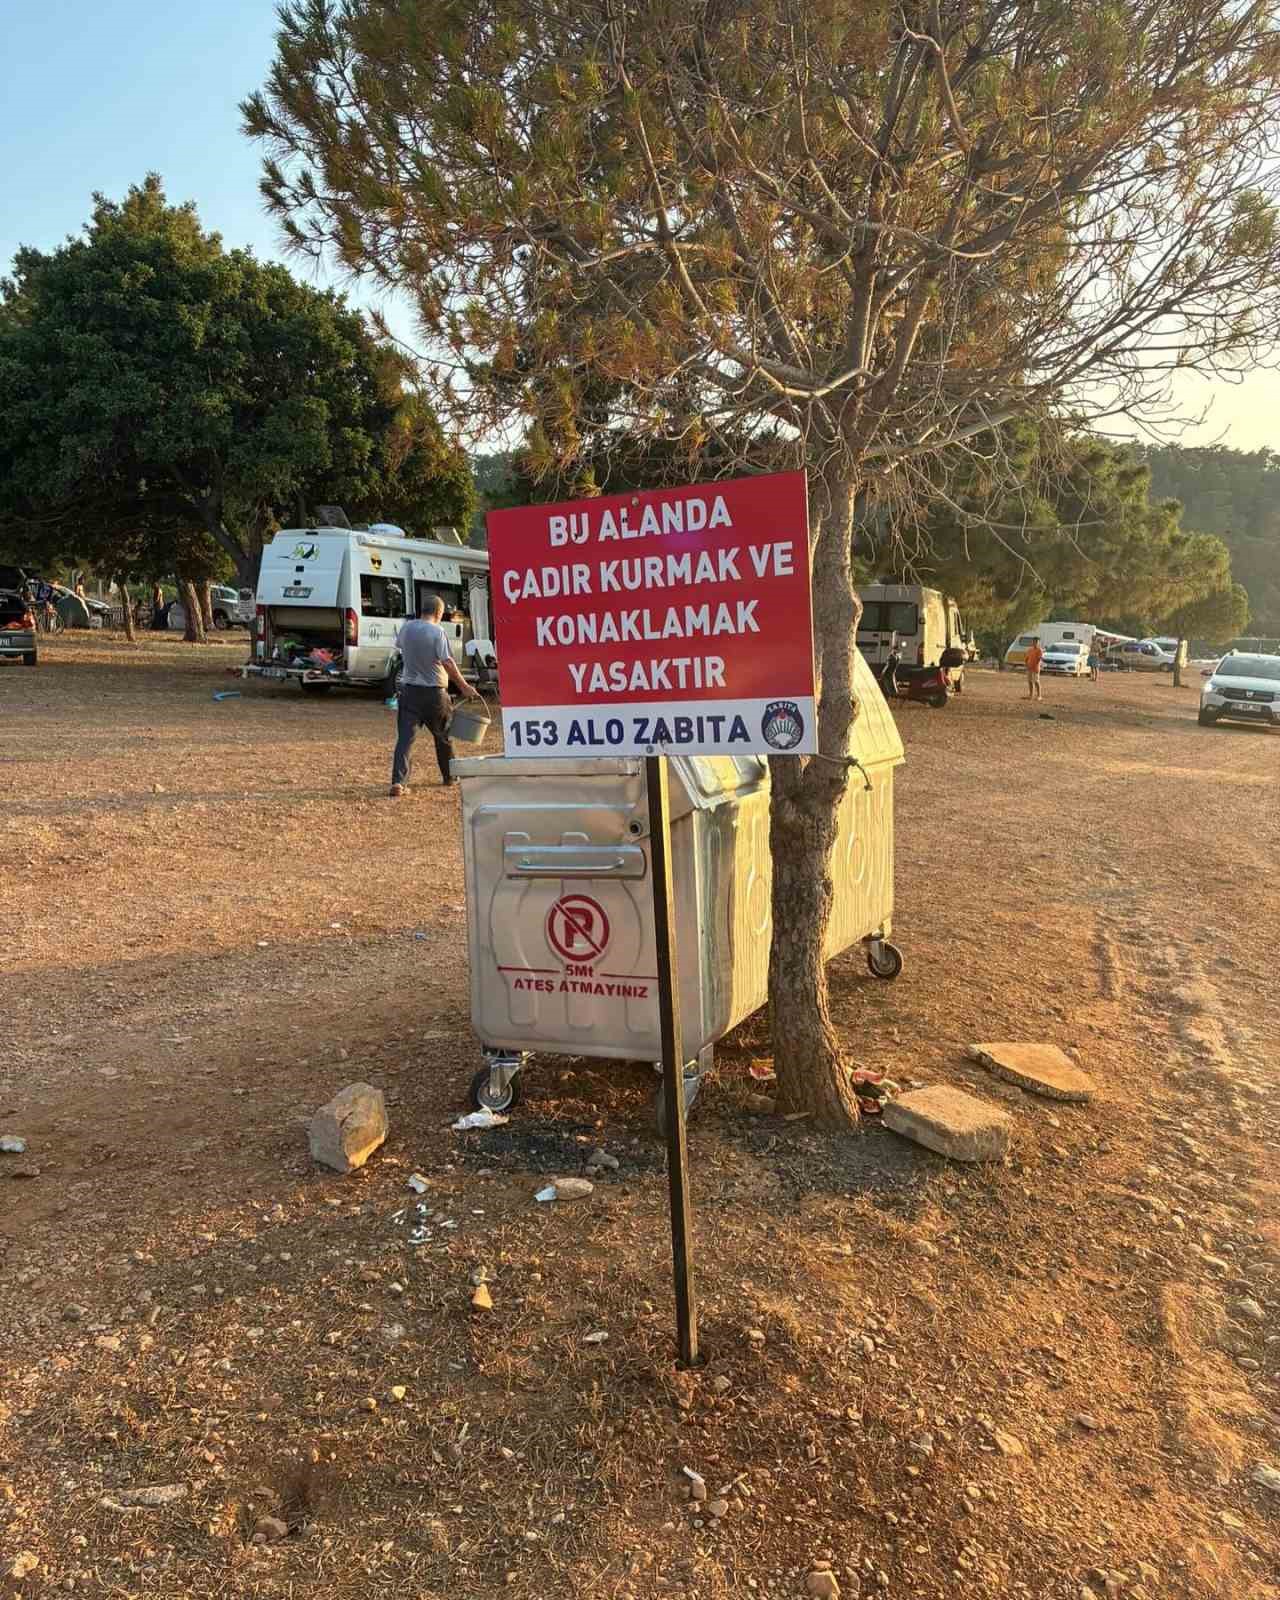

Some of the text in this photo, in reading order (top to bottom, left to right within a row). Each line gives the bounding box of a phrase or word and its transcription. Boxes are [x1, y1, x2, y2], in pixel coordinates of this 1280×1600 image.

[549, 495, 732, 547] BU ALANDA
[503, 541, 794, 604] ÇADIR KURMAK VE
[536, 599, 761, 647] KONAKLAMAK
[568, 655, 727, 693] YASAKTIR
[510, 714, 751, 746] 153 ALO ZABITA
[514, 978, 649, 999] ATEŞ ATMAYINIZ
